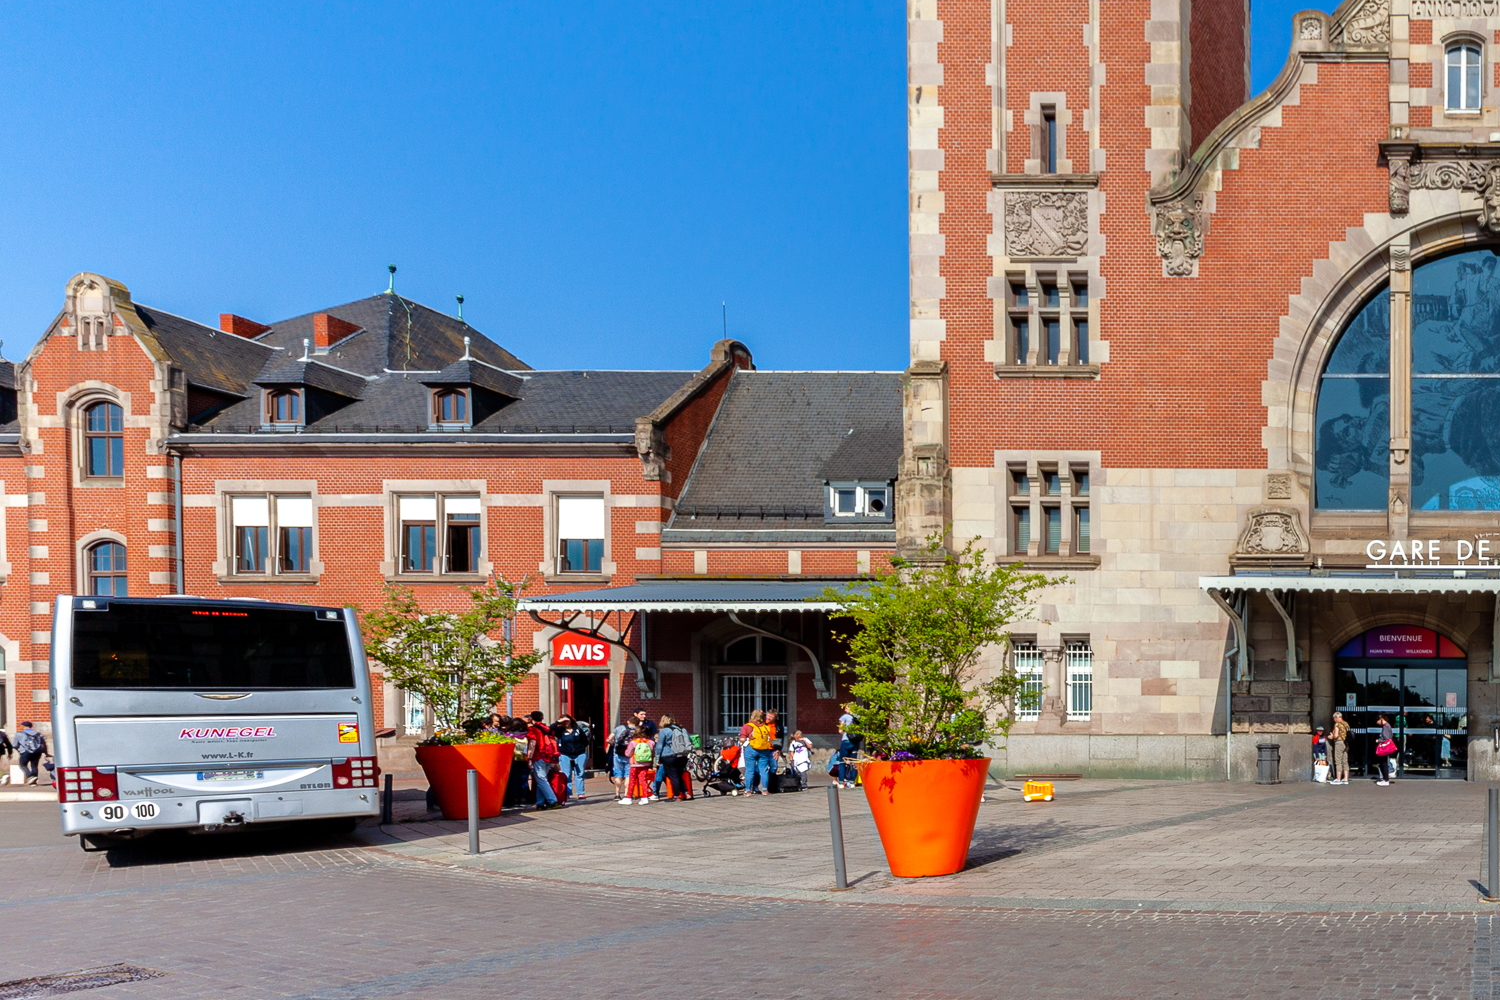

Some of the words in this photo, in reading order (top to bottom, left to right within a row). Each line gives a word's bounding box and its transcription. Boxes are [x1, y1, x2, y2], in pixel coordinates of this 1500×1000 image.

[1411, 0, 1455, 17] ANNO
[1366, 540, 1441, 561] GARE
[1457, 540, 1490, 561] DE
[559, 644, 605, 661] AVIS
[179, 727, 277, 739] KUNEGEL
[104, 806, 124, 820] 90
[135, 803, 155, 818] 100
